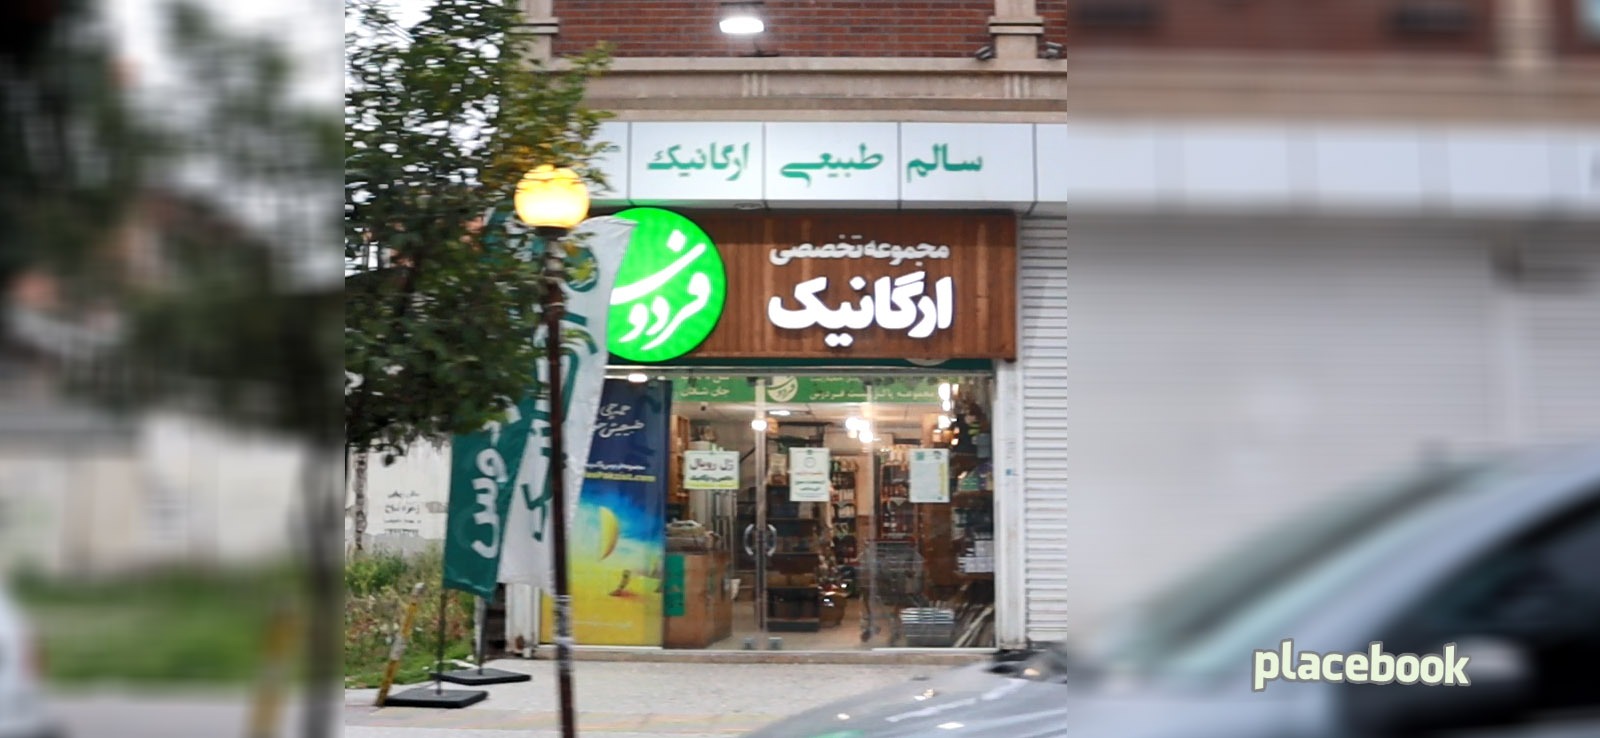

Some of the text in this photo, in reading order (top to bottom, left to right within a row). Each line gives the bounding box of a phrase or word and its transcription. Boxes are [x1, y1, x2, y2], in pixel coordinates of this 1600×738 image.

[646, 142, 985, 187] سالم طبیعی ارگانیک
[769, 234, 950, 267] مجموعه تخصصی
[767, 271, 954, 348] ارگانیک
